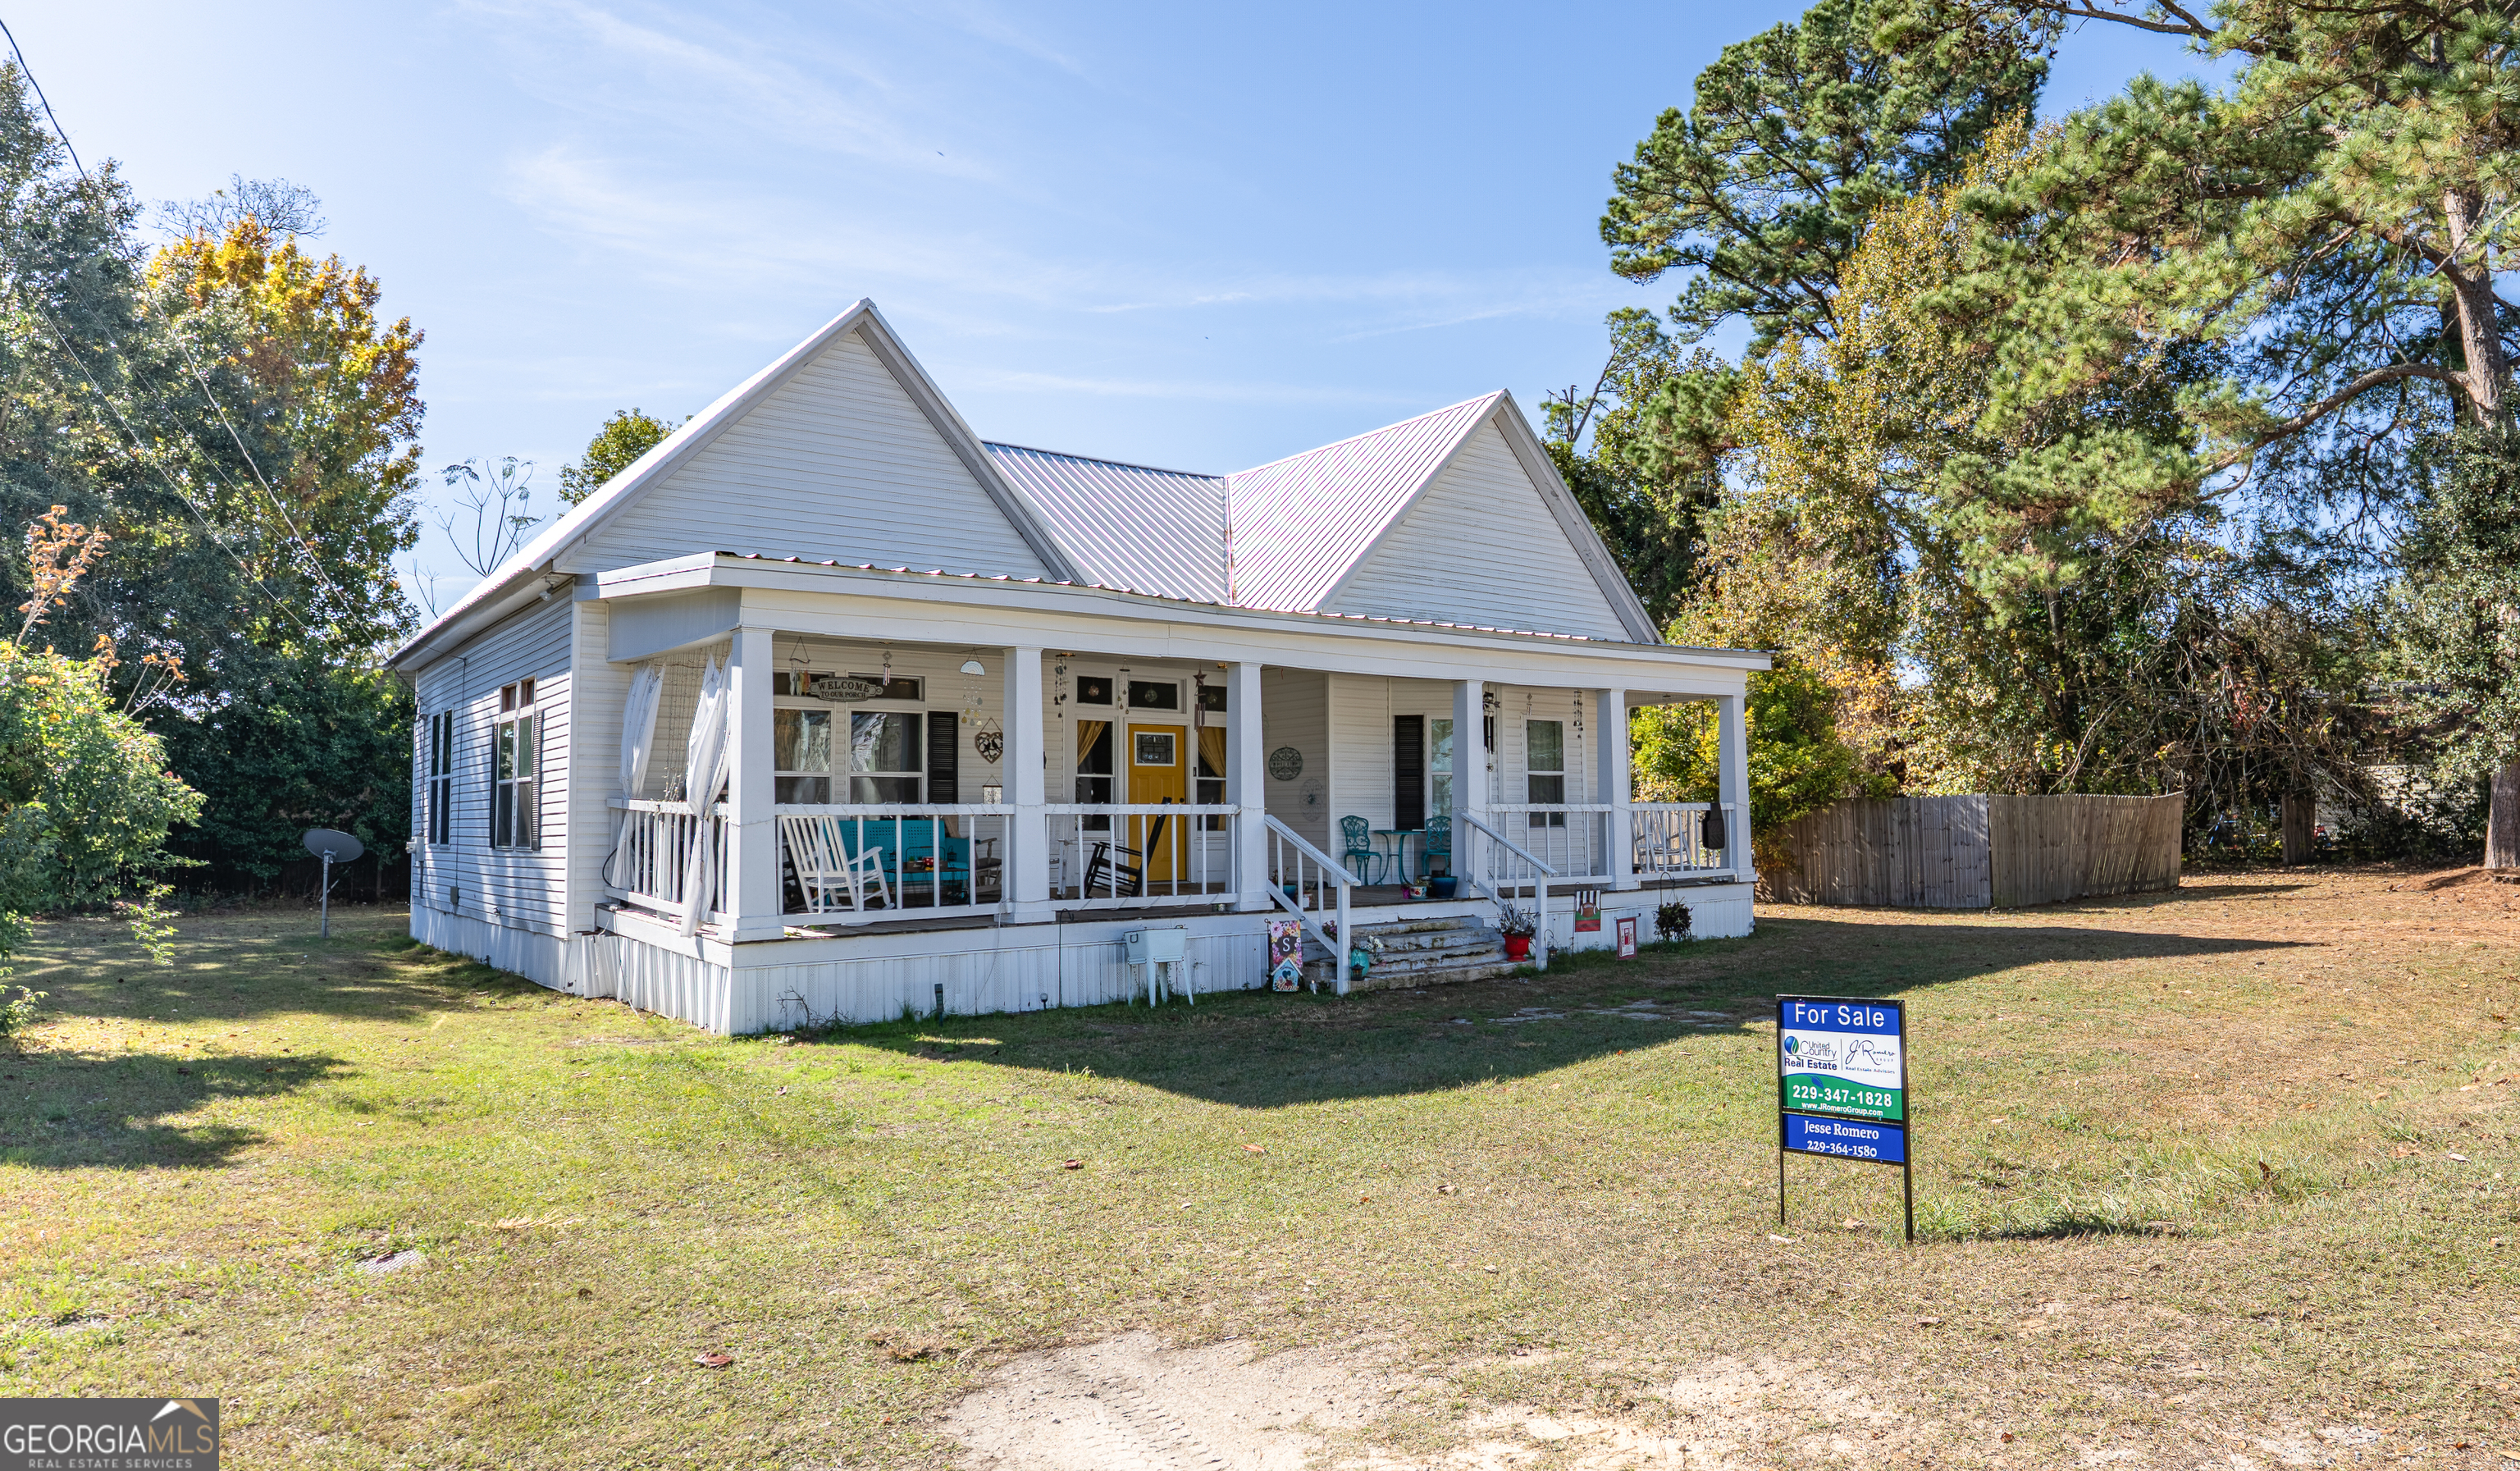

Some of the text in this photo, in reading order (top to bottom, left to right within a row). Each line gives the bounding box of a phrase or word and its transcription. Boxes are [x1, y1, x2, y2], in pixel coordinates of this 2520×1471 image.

[817, 681, 870, 692] WELCOME
[1282, 938, 1290, 952] S
[1795, 1003, 1885, 1027] For Sale
[1800, 1040, 1837, 1058] Country
[1808, 1041, 1830, 1049] United
[1784, 1058, 1838, 1071] Real Estate
[1792, 1085, 1892, 1107] 229-347-1828
[1801, 1102, 1883, 1117] www.JRomeroGroup.com
[1804, 1120, 1879, 1140] Jesse Romero
[1806, 1140, 1878, 1158] 229-364-1580
